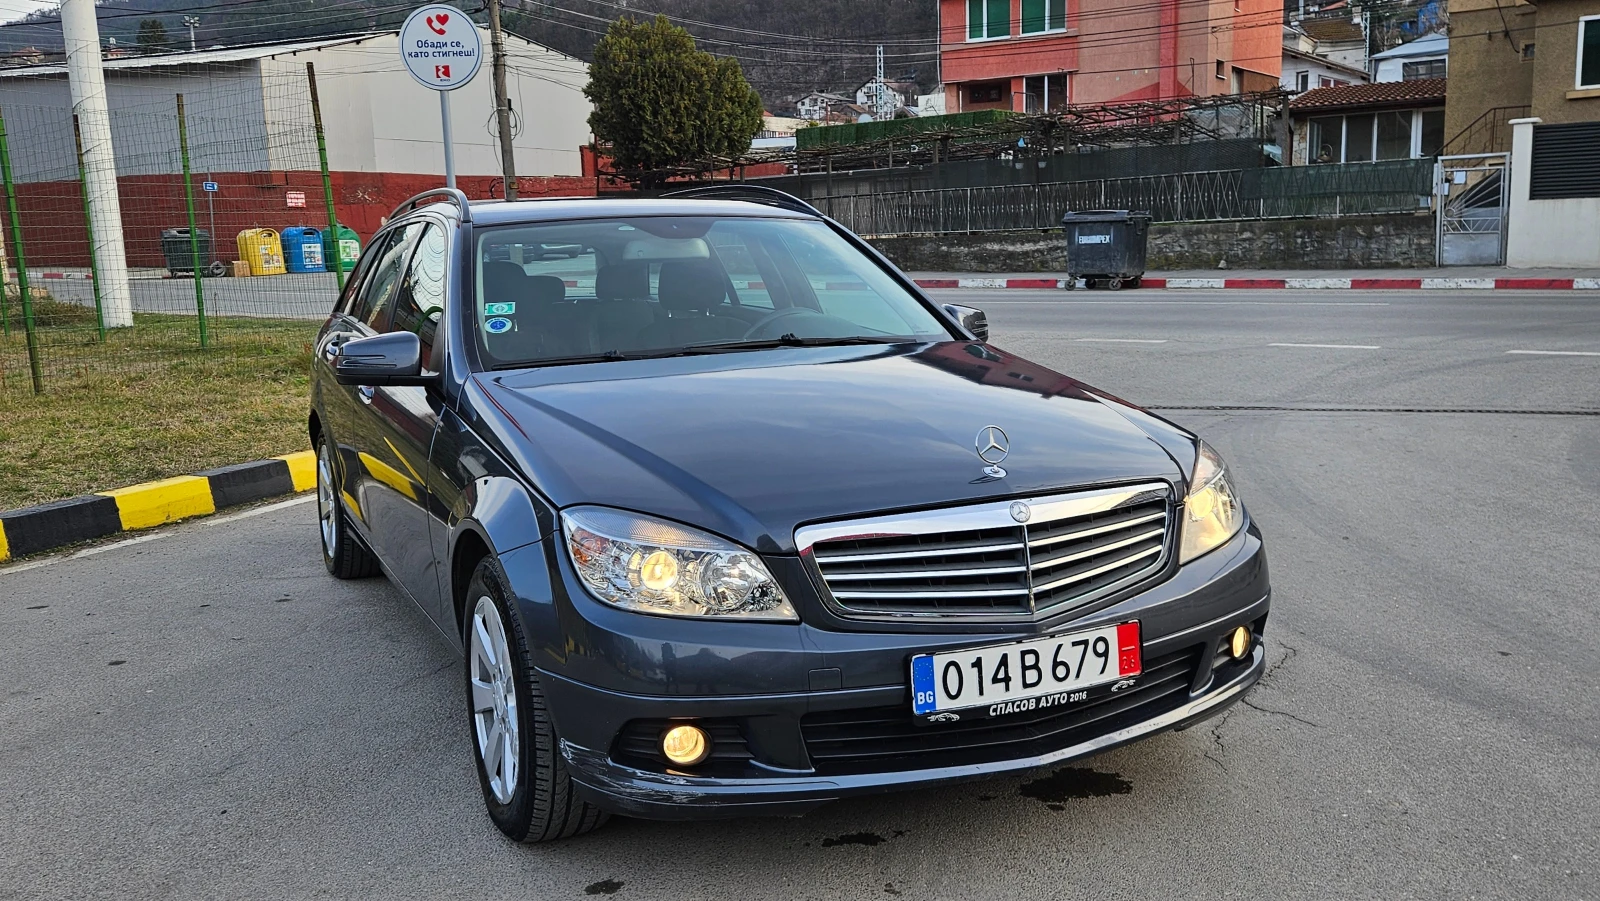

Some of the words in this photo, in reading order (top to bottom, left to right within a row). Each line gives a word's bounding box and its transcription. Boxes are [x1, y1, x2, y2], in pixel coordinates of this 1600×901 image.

[416, 39, 447, 49] Обади
[450, 40, 464, 49] се,
[432, 48, 475, 58] стигнеш!
[917, 690, 934, 705] BG
[989, 698, 1036, 716] СПАСОВ
[1038, 692, 1068, 708] АУТО
[1069, 691, 1087, 702] 2016
